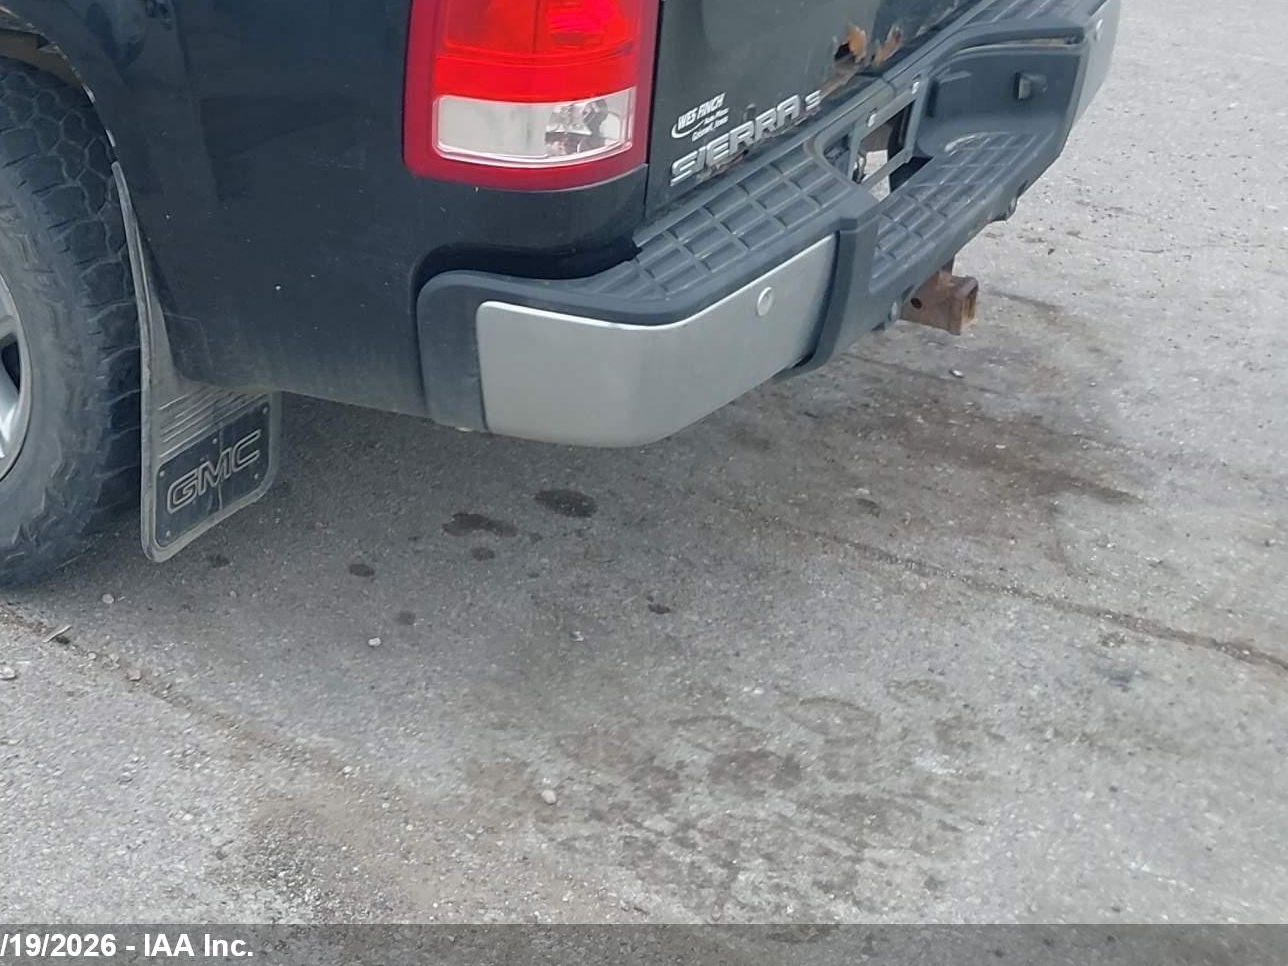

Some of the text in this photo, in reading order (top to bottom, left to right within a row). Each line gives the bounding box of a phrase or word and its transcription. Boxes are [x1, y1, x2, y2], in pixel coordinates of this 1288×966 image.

[670, 94, 801, 187] SIERRA
[677, 107, 699, 131] WES
[697, 92, 726, 120] FINCH
[167, 428, 262, 515] GMC
